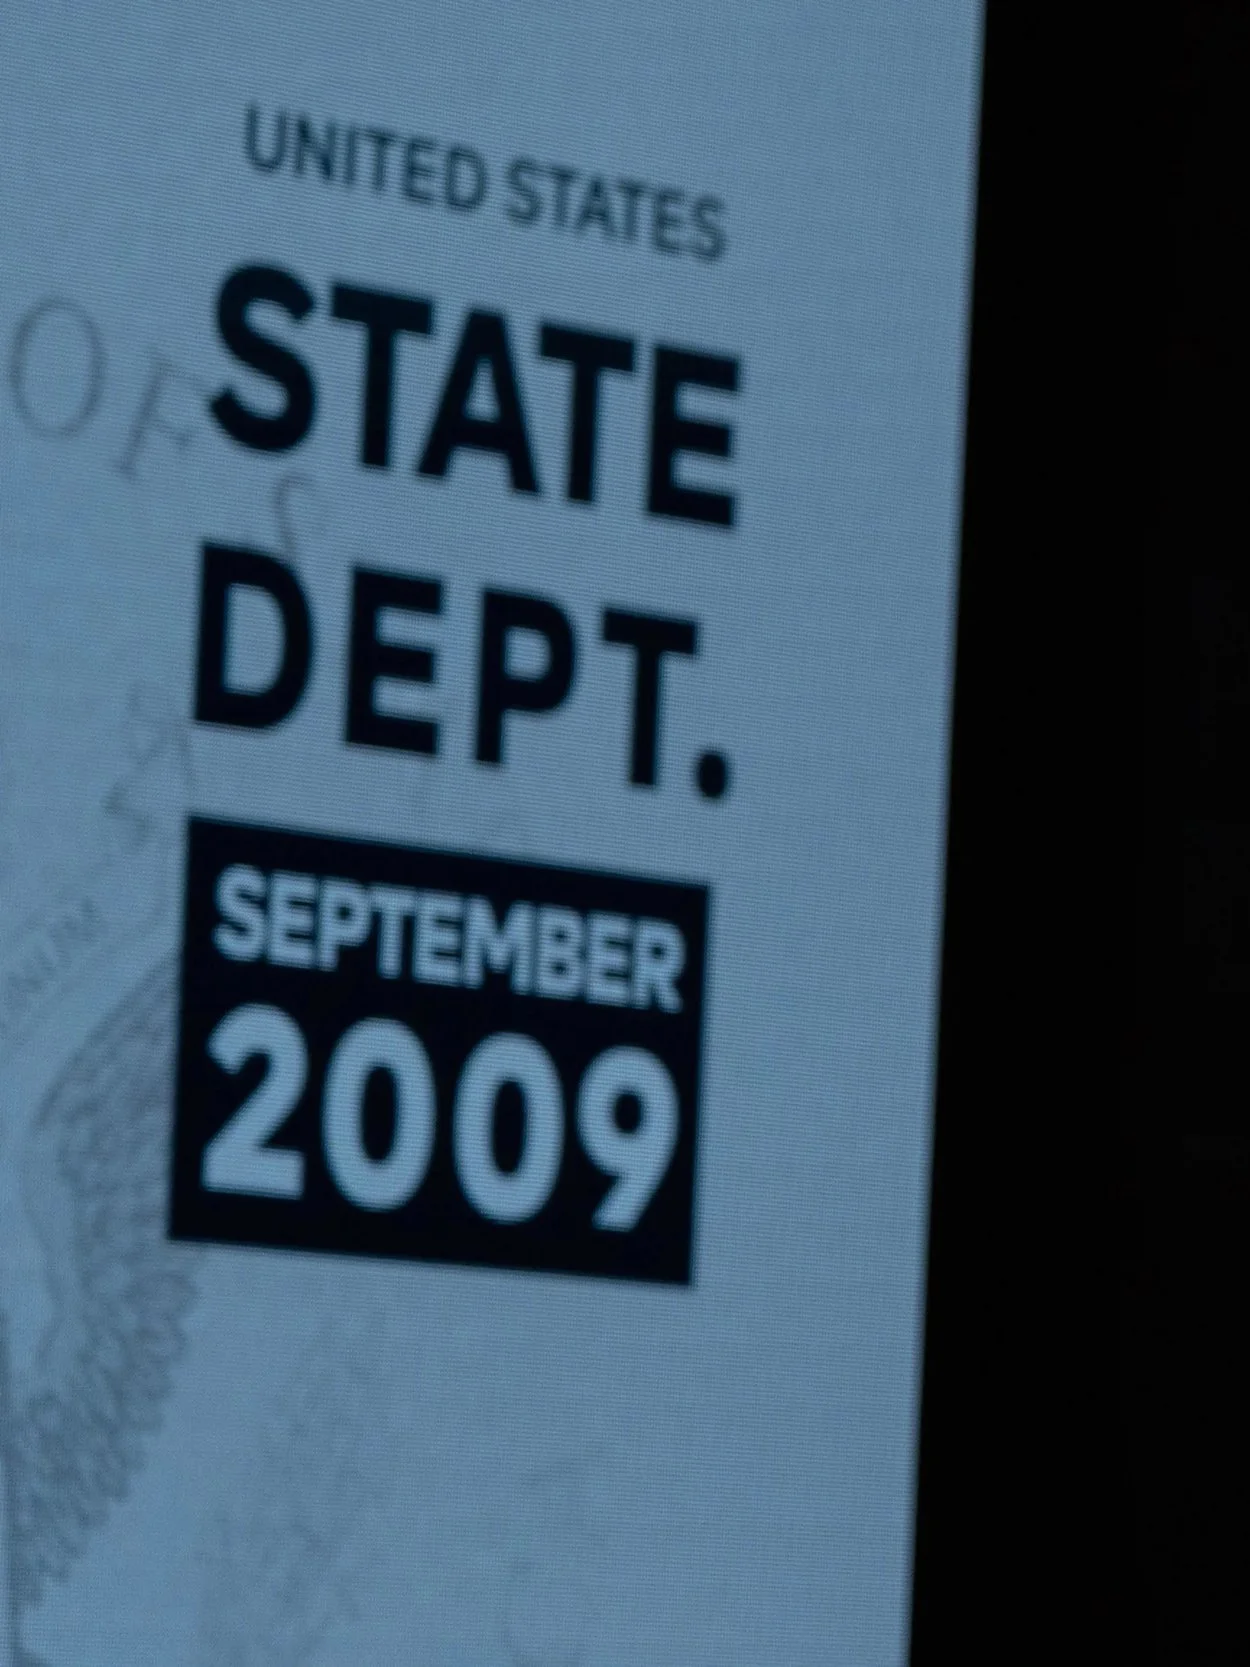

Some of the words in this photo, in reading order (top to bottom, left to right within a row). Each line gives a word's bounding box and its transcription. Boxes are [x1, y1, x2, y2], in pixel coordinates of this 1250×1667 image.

[243, 101, 490, 215] UNITED
[502, 155, 729, 263] STATES
[208, 261, 742, 530] STATE
[192, 539, 732, 802] DEPT.
[215, 864, 685, 1011] SEPTEMBER
[202, 1004, 678, 1228] 2009
